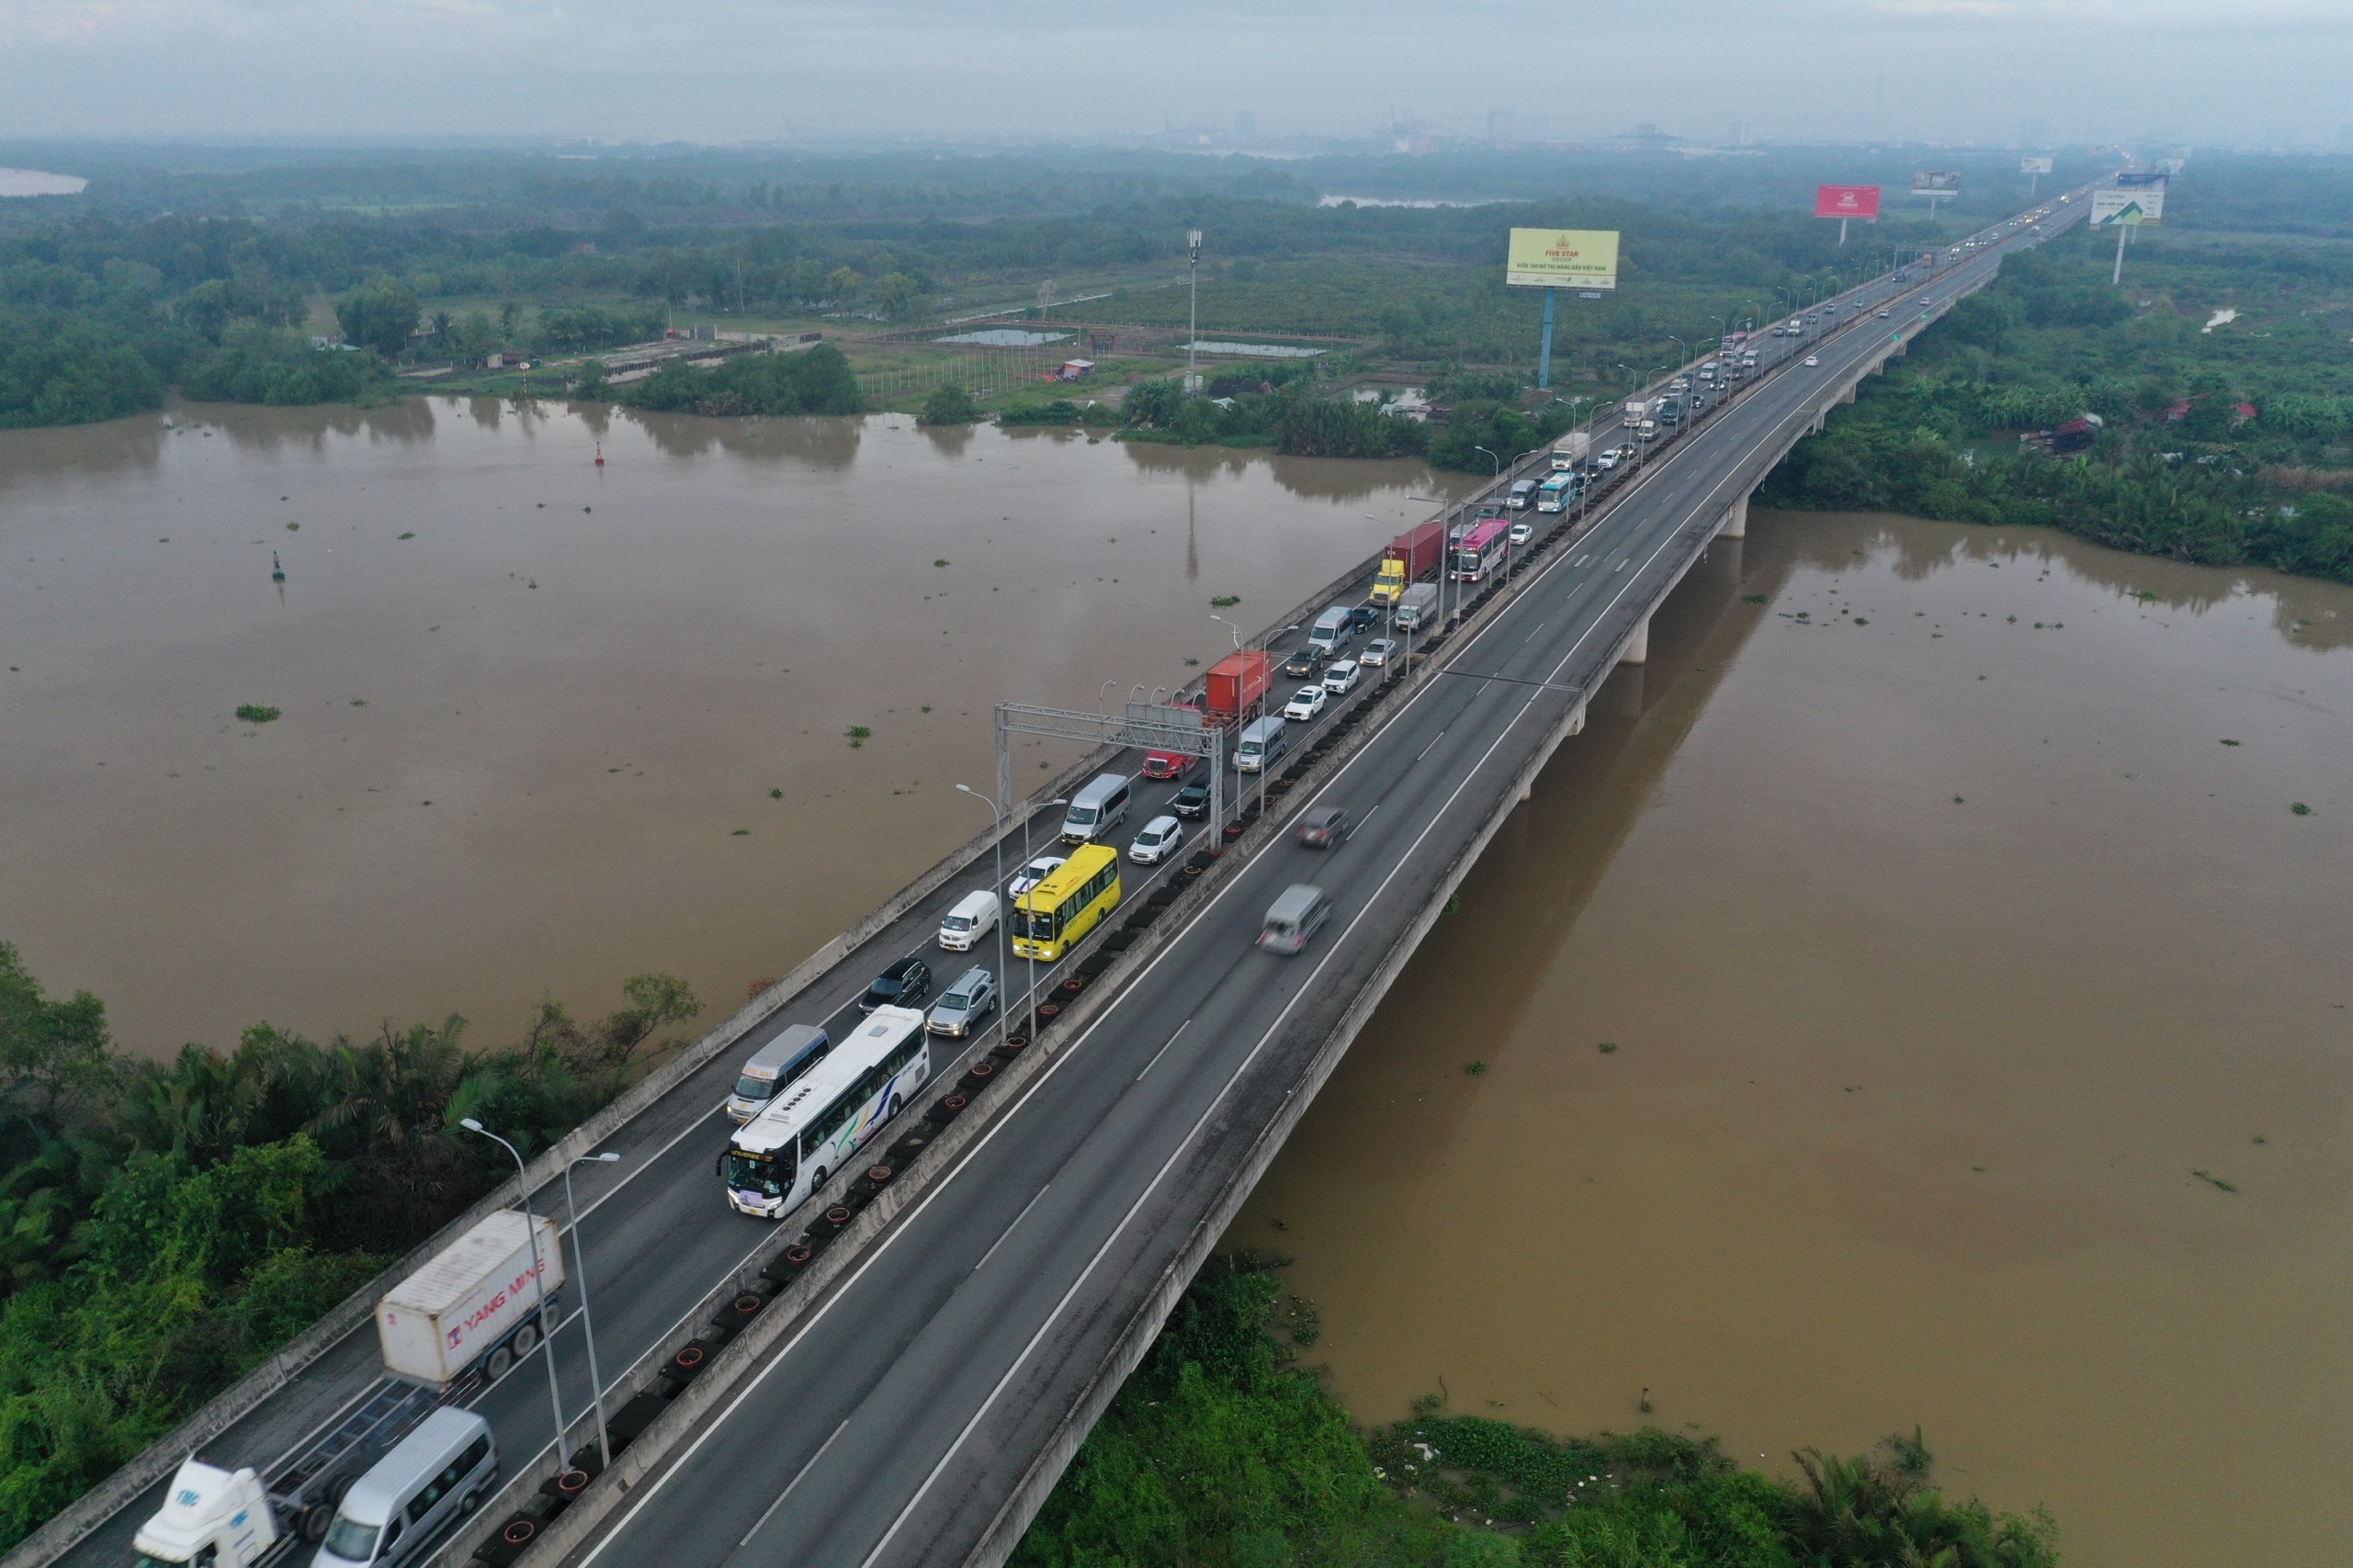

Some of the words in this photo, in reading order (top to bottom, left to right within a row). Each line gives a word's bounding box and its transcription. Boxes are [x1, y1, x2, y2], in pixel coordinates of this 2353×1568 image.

[464, 1291, 506, 1331] YANG
[509, 1258, 545, 1297] MING
[175, 1489, 200, 1507] TMC
